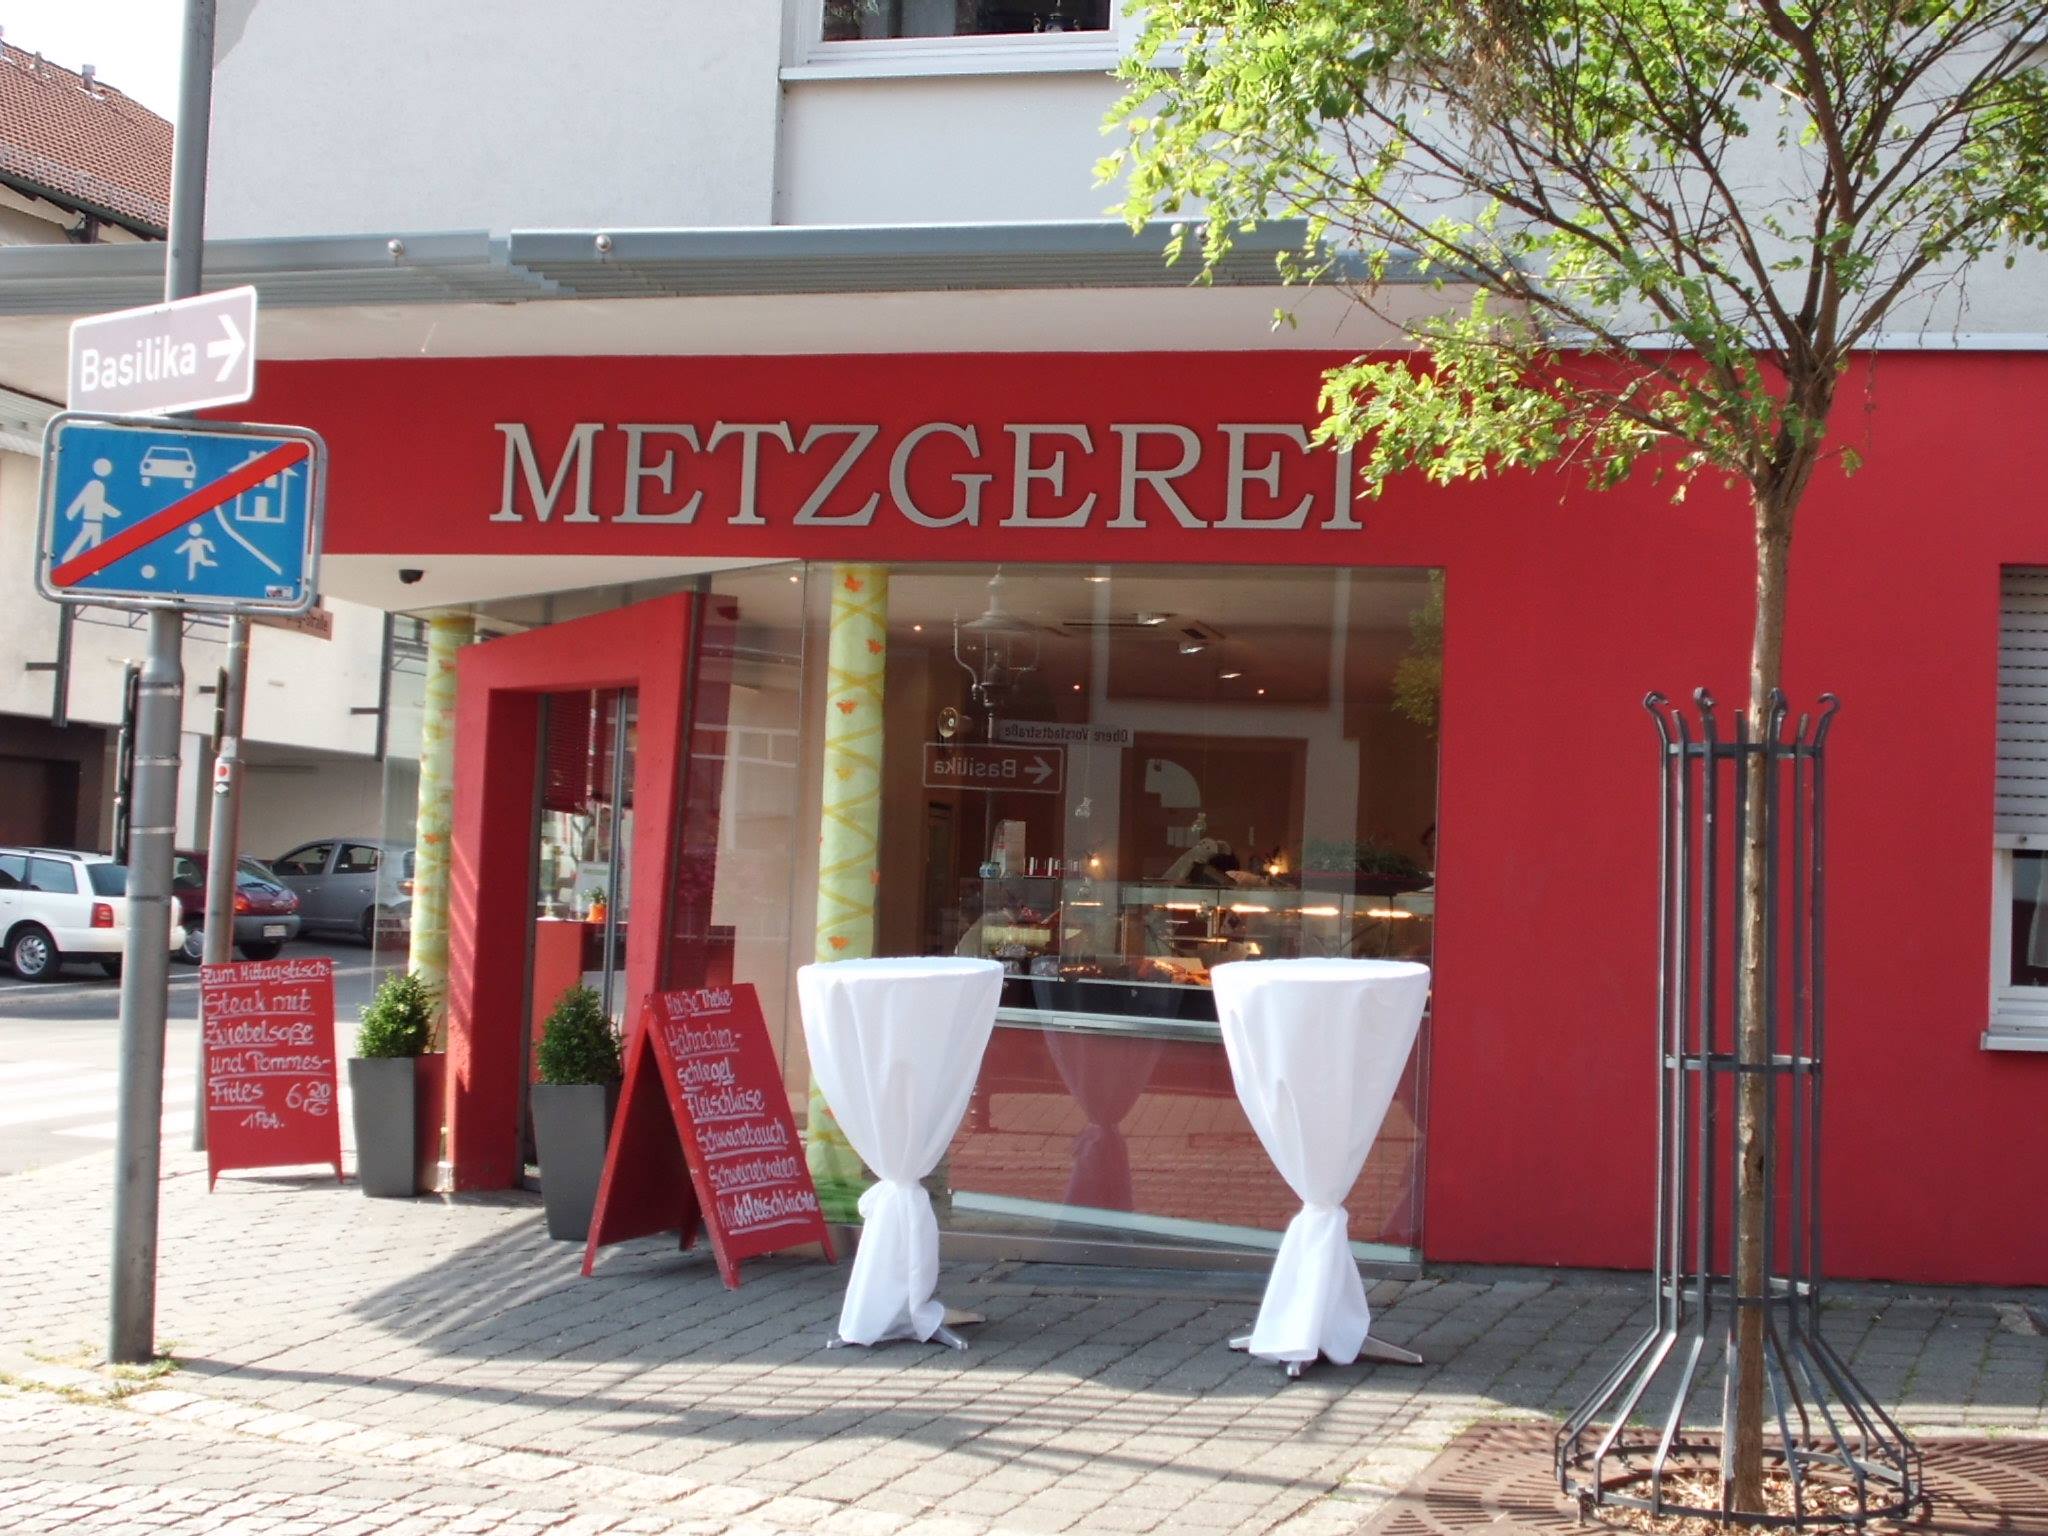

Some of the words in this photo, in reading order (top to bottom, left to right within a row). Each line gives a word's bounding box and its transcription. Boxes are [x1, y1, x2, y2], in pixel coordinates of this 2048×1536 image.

[80, 335, 197, 393] Basilika
[489, 420, 1363, 531] METZGEREI
[203, 988, 267, 1013] Steak
[271, 987, 312, 1012] mit
[204, 1020, 315, 1046] Zwiebelsoße
[210, 1053, 245, 1073] und
[208, 1080, 265, 1105] Frites
[681, 1086, 766, 1120] Fleischkäse
